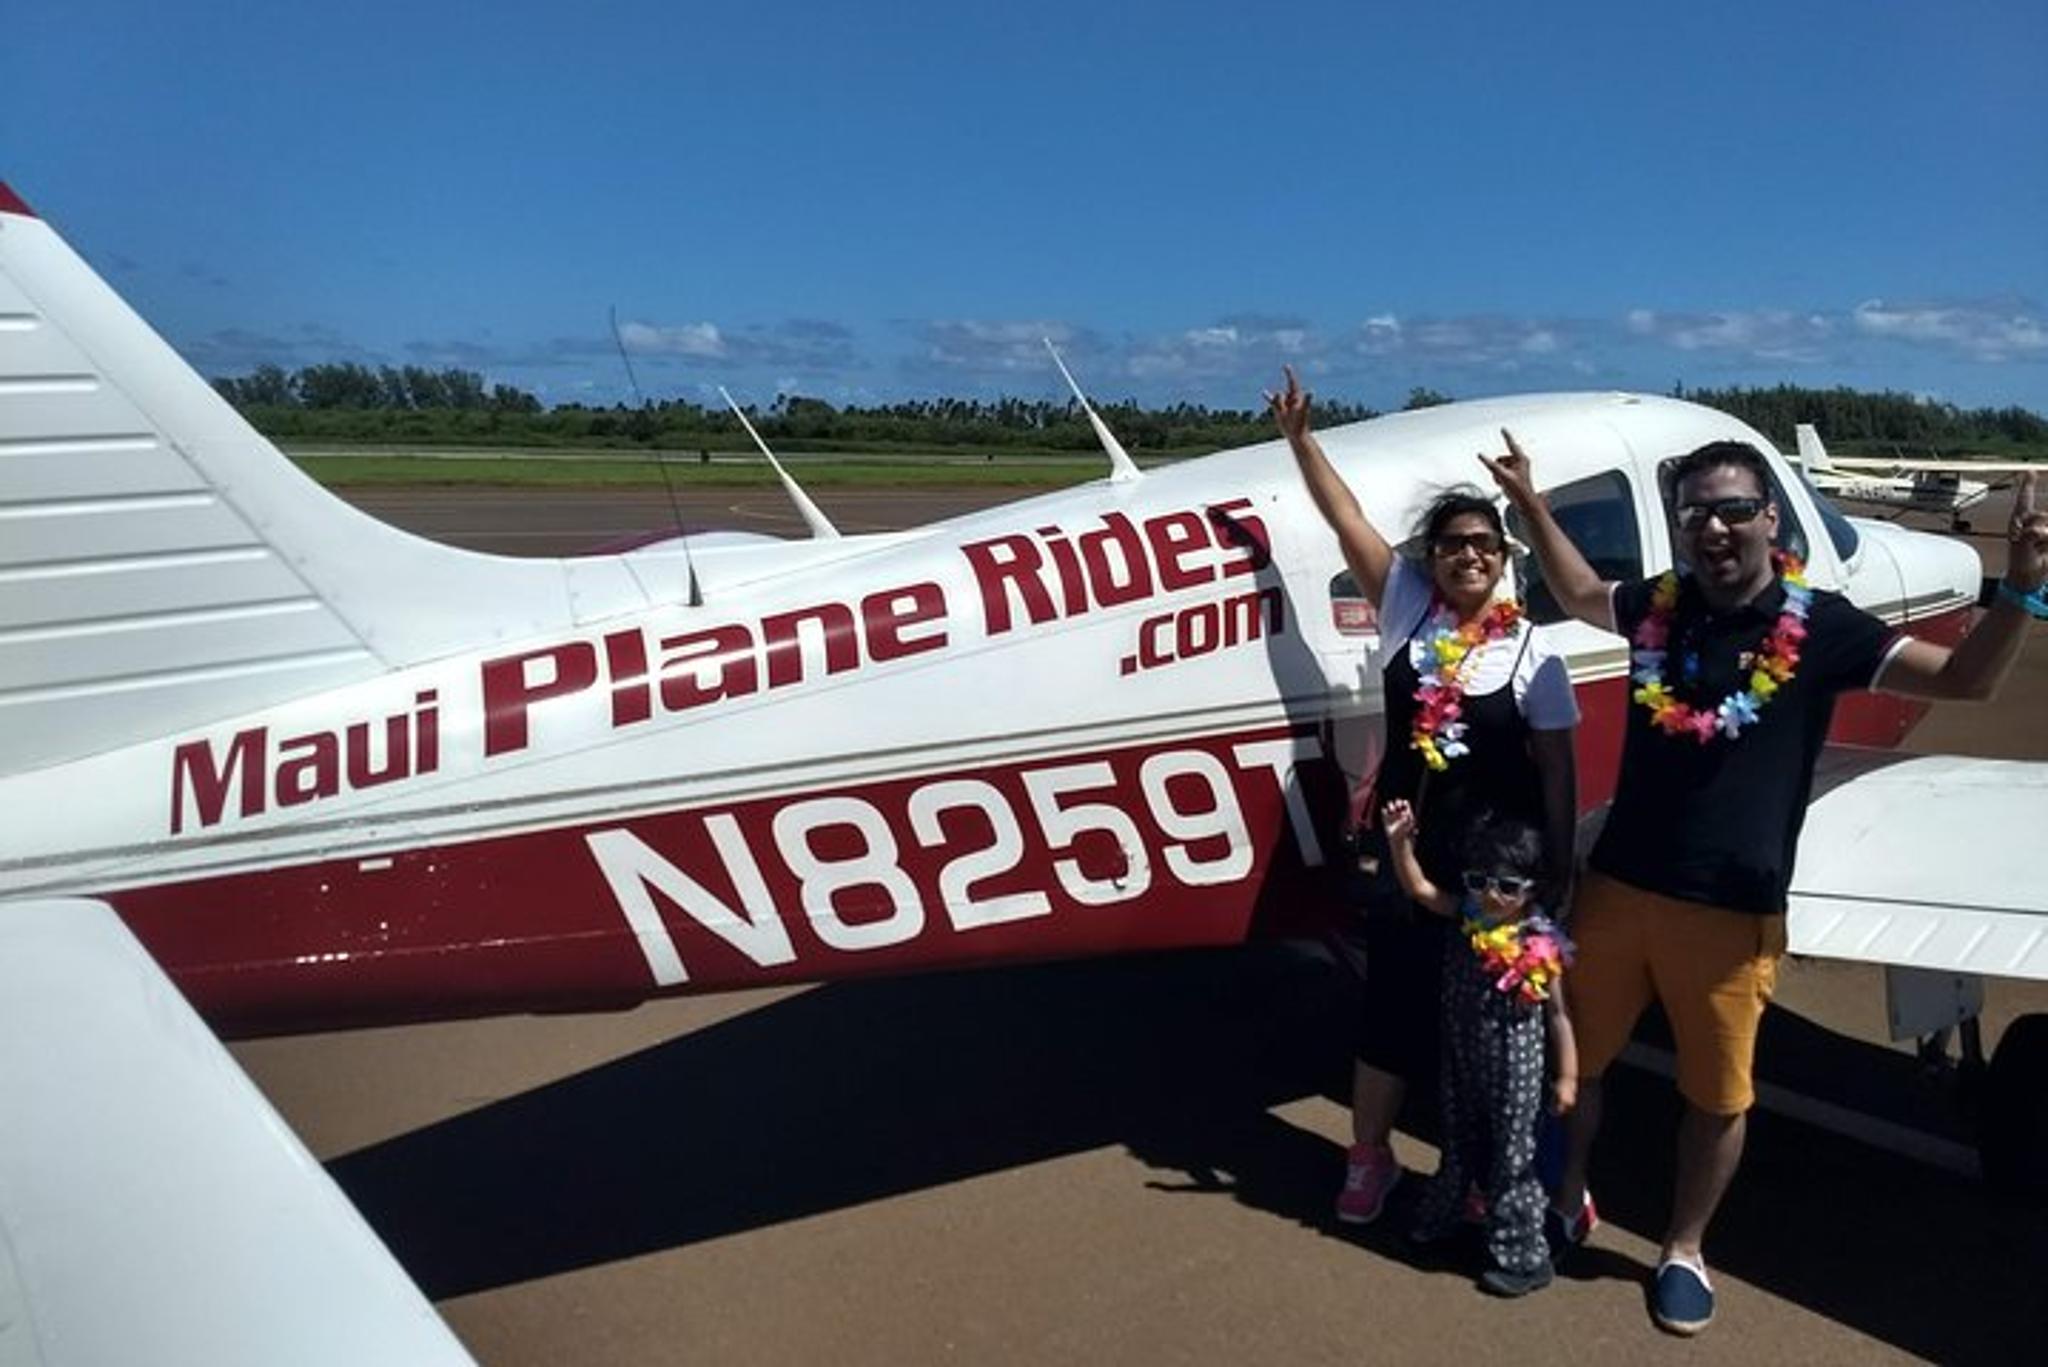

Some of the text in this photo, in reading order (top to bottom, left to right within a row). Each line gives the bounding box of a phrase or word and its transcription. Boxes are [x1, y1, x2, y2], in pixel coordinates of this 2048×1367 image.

[170, 497, 1271, 835] Maui Plane Rides
[1120, 586, 1284, 676] .com
[585, 737, 1324, 987] N8259T
